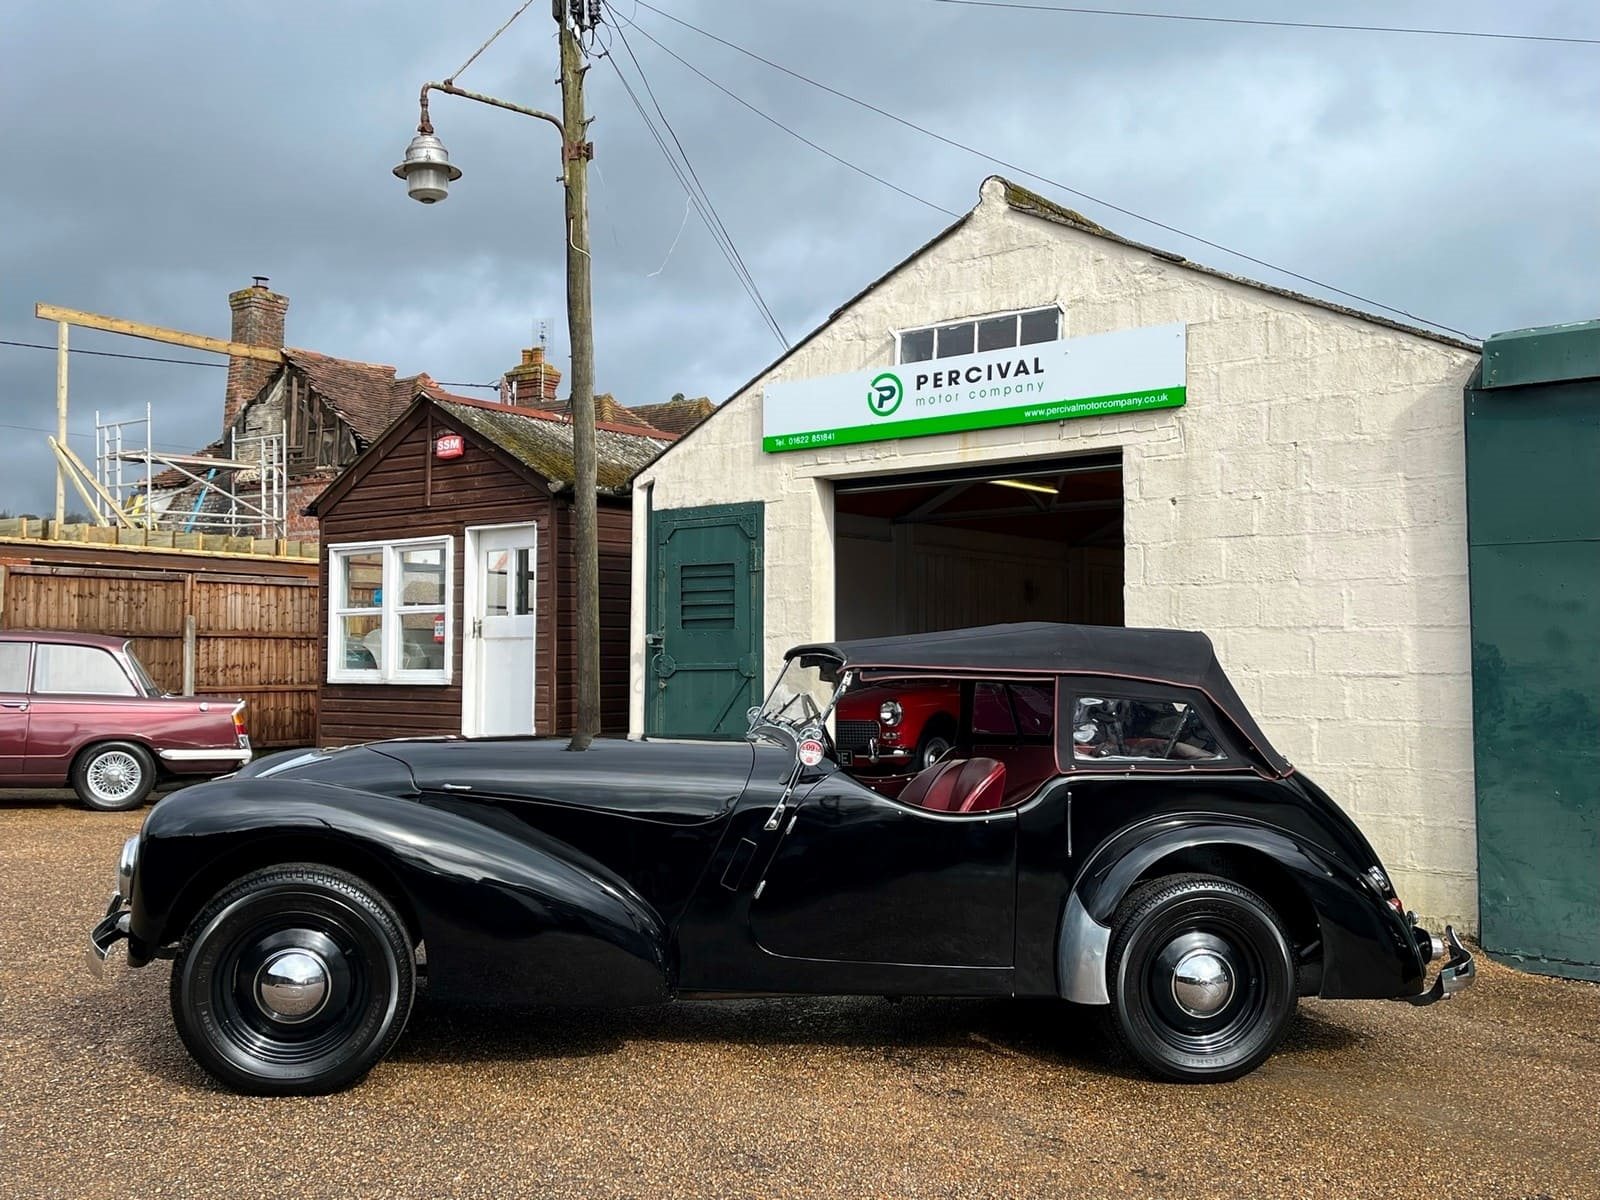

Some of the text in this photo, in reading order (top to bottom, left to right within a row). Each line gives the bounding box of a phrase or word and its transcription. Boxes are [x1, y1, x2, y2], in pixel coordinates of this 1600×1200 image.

[916, 356, 1044, 391] PERCIVAL
[915, 381, 1045, 407] motor company
[1024, 393, 1168, 417] www.percivalmotorcompany.co.uk
[438, 439, 459, 451] SSM
